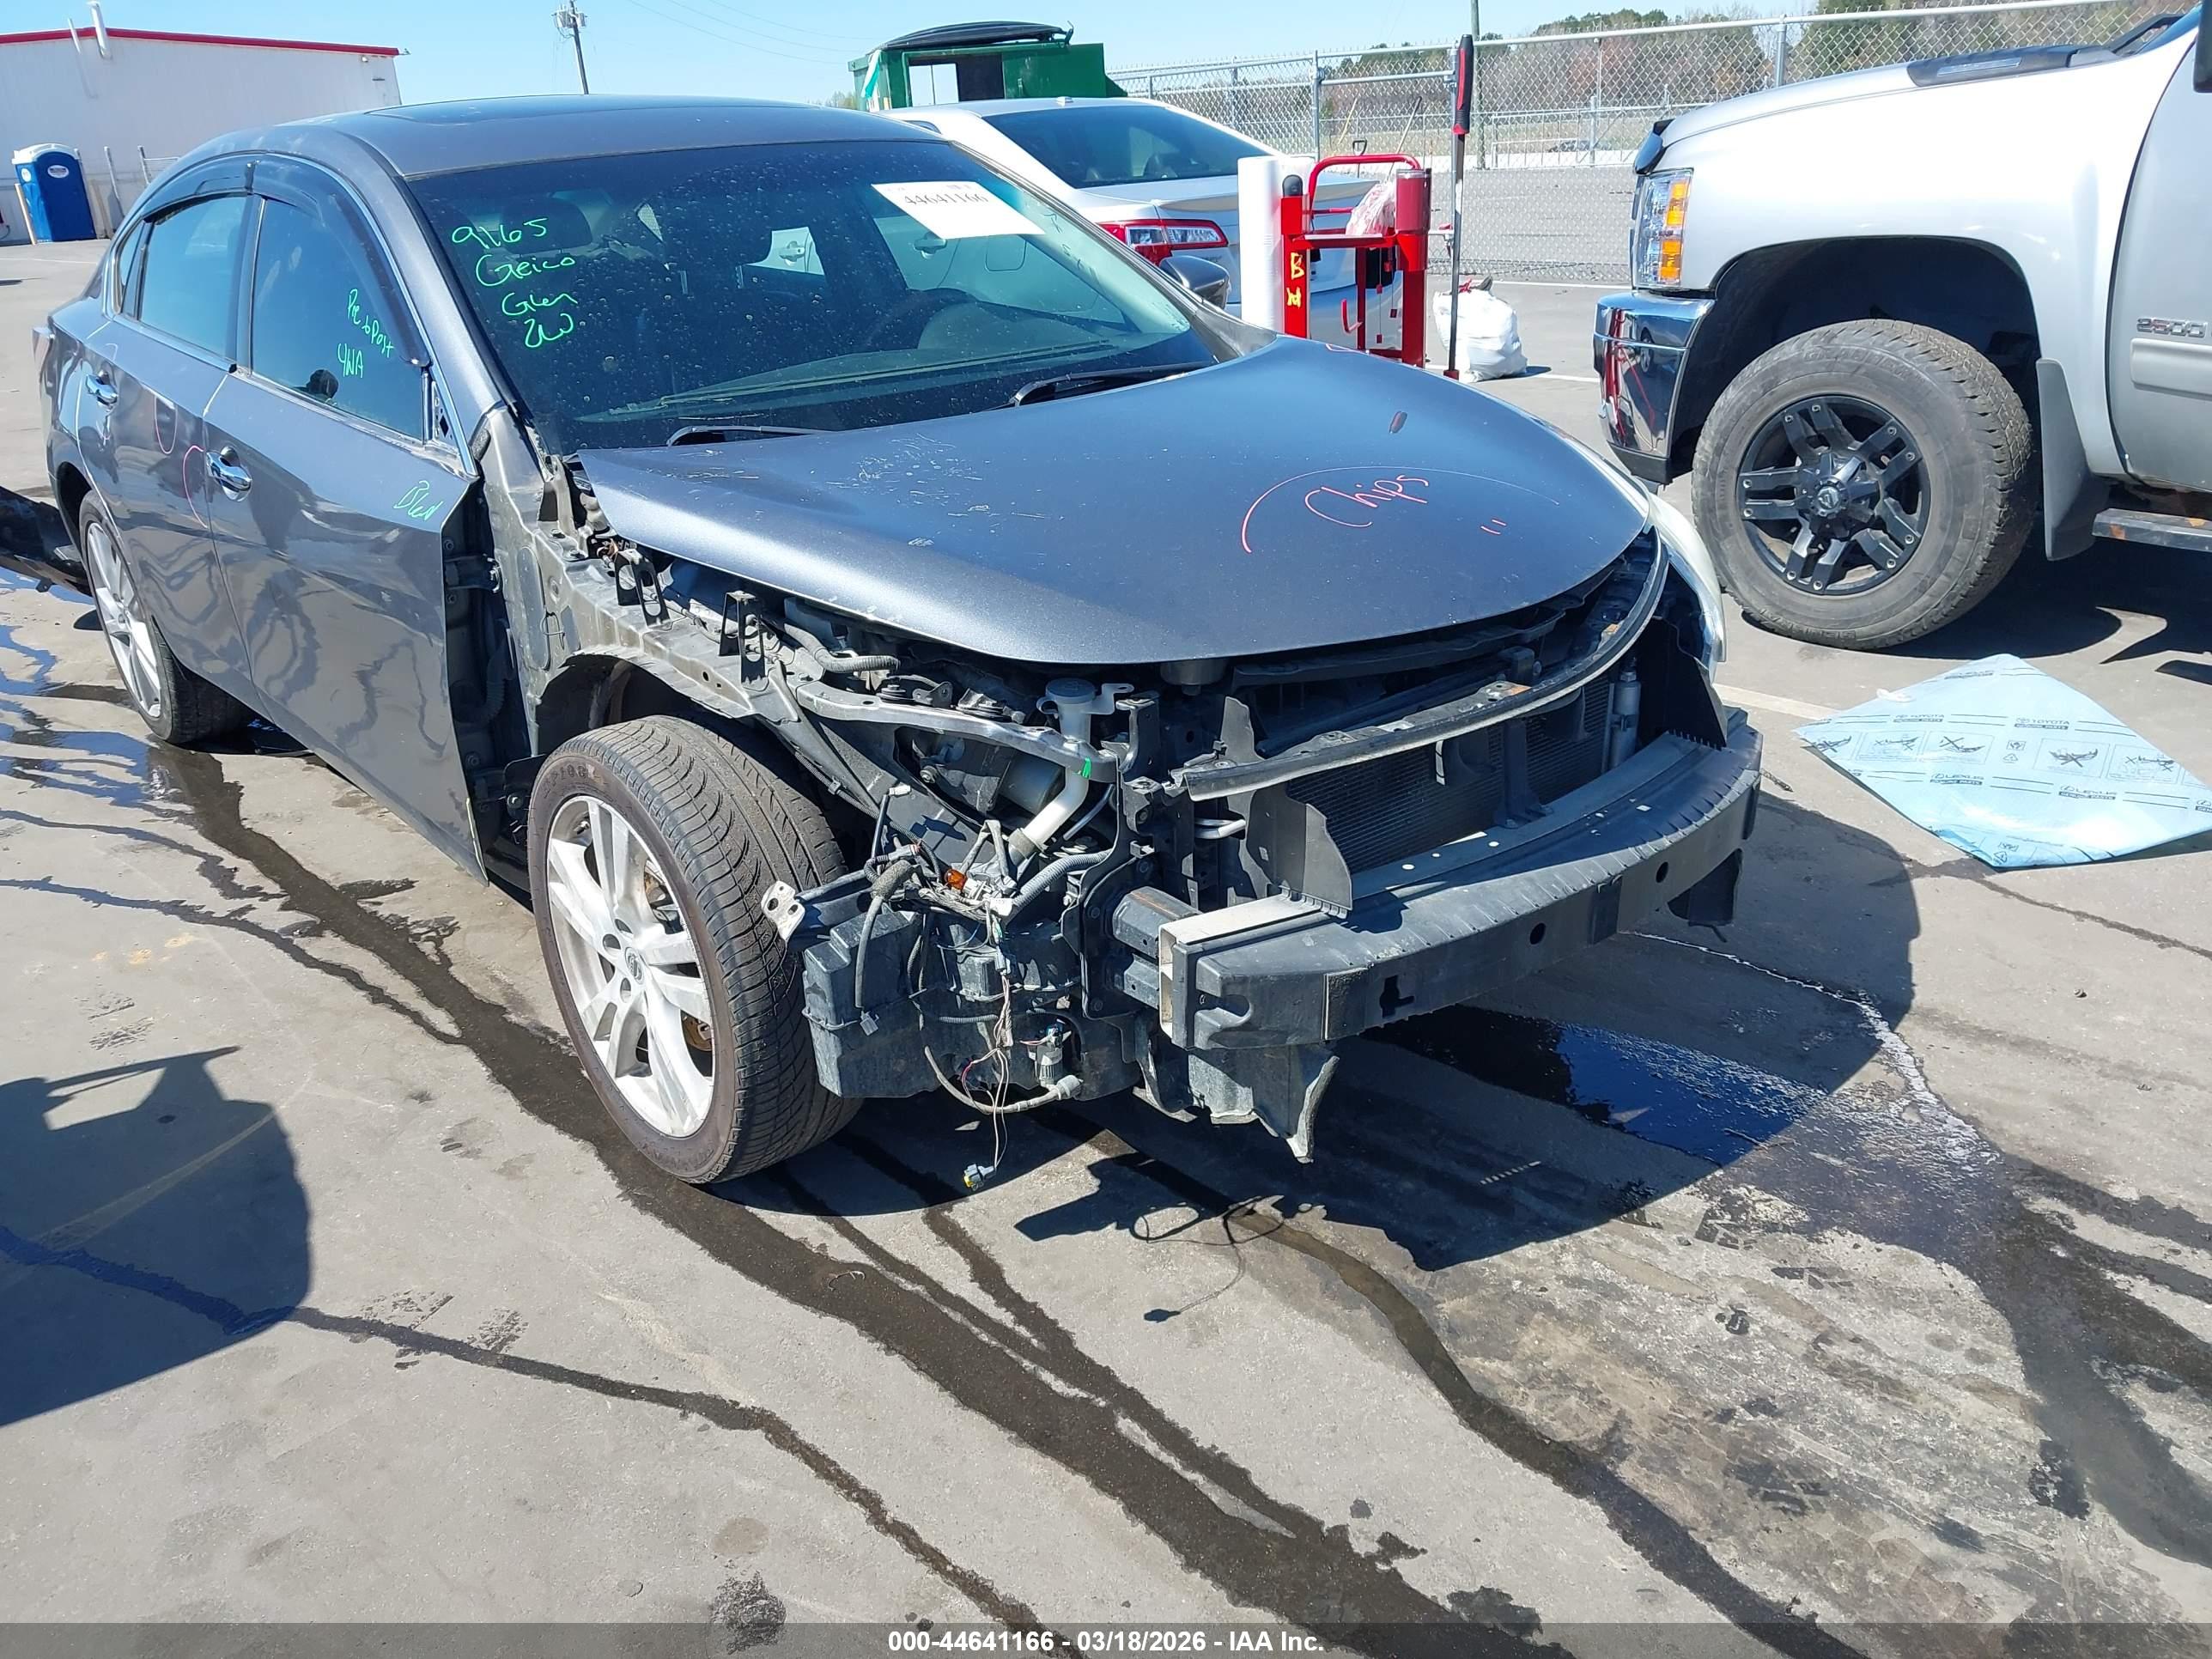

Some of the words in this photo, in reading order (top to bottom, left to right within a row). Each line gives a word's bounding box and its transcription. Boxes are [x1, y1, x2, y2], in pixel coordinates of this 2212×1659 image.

[452, 217, 548, 250] 9165
[475, 254, 576, 287] Geico
[371, 319, 394, 358] Post
[2136, 317, 2207, 338] 2500
[1304, 474, 1430, 528] Chips
